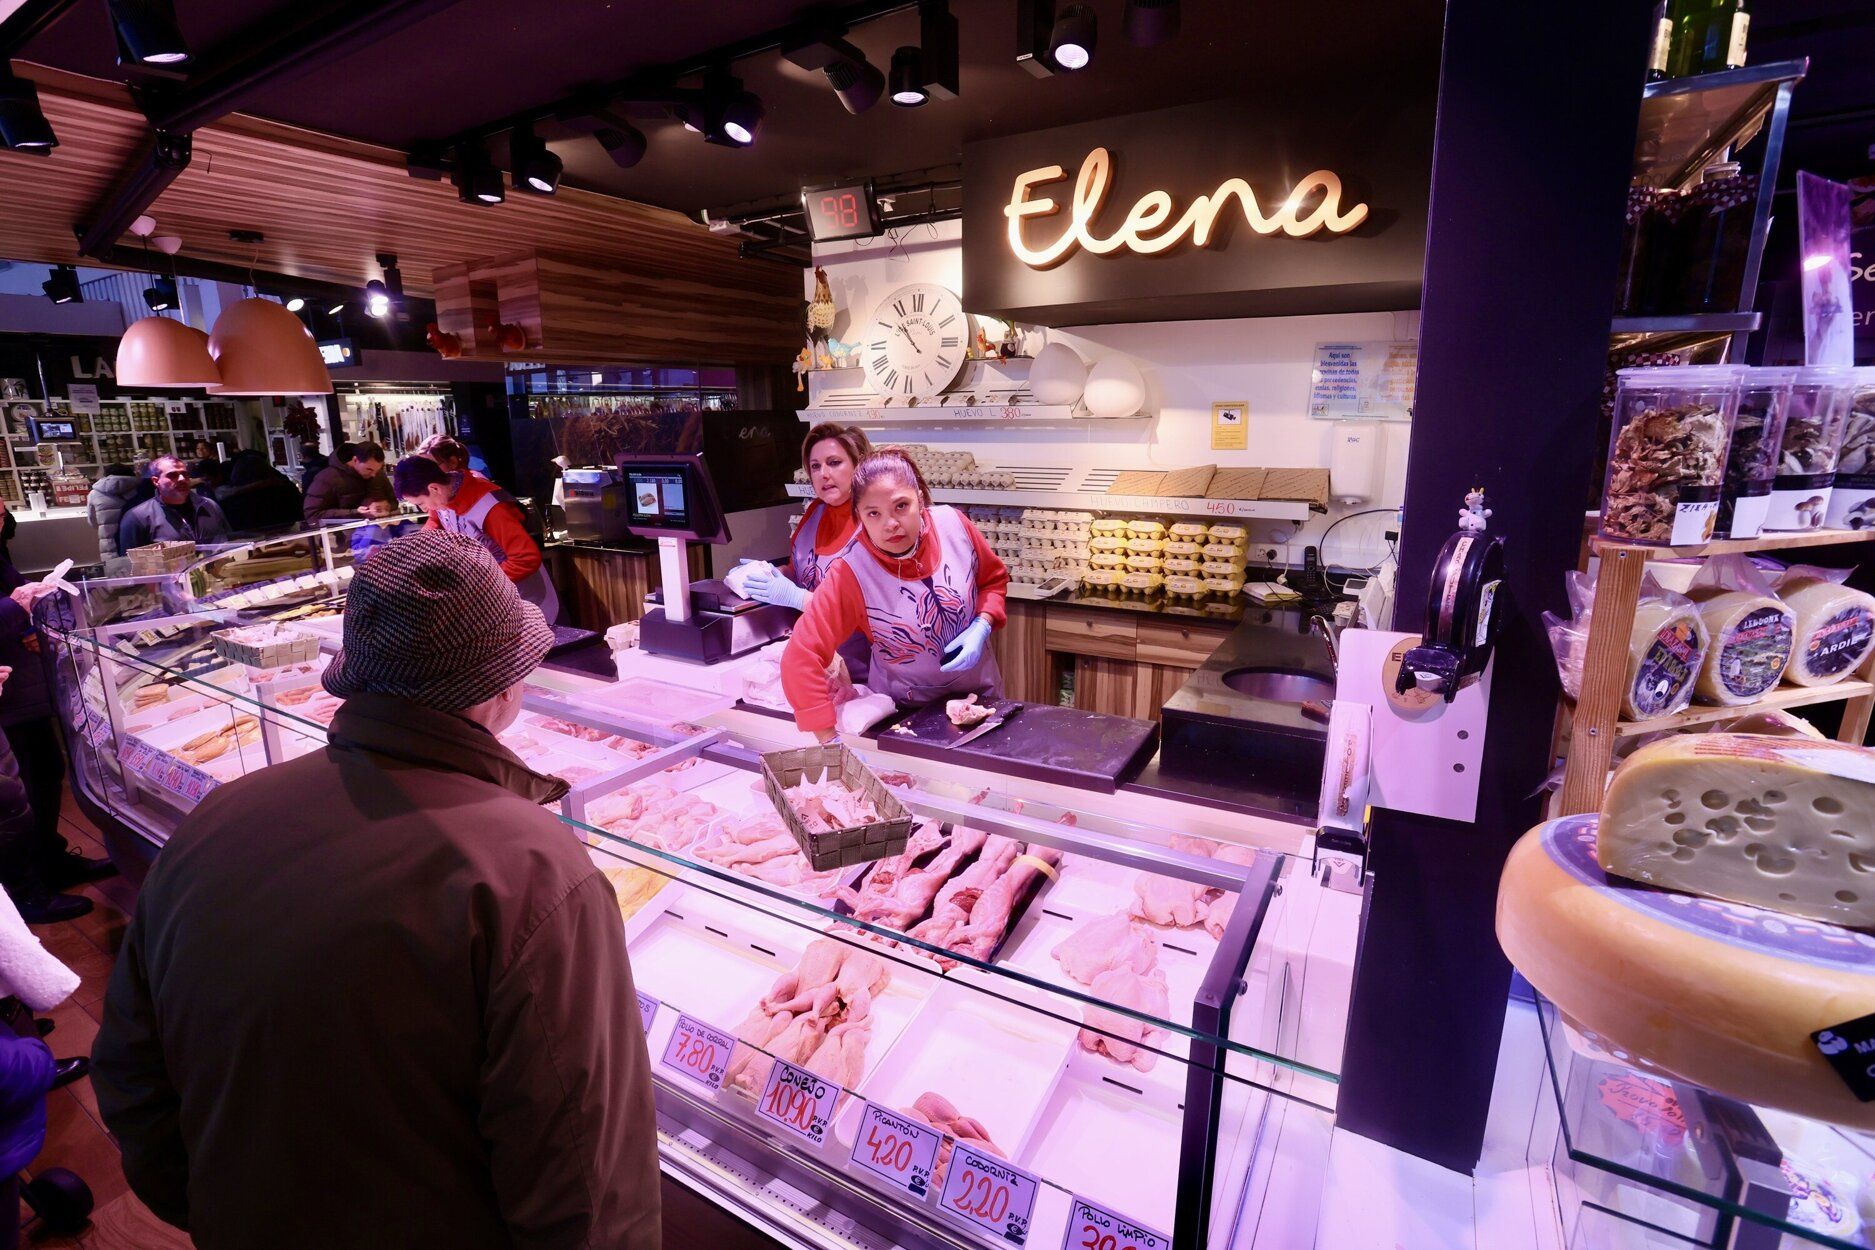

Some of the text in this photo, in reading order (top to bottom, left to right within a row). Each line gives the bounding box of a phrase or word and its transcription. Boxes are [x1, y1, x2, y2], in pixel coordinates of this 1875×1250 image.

[1003, 147, 1369, 268] Elena
[954, 408, 983, 418] HUEVO
[705, 1080, 719, 1090] KILO
[780, 1065, 826, 1100] CONEJO
[807, 1132, 822, 1144] KILO
[1078, 1206, 1111, 1228] POLLO
